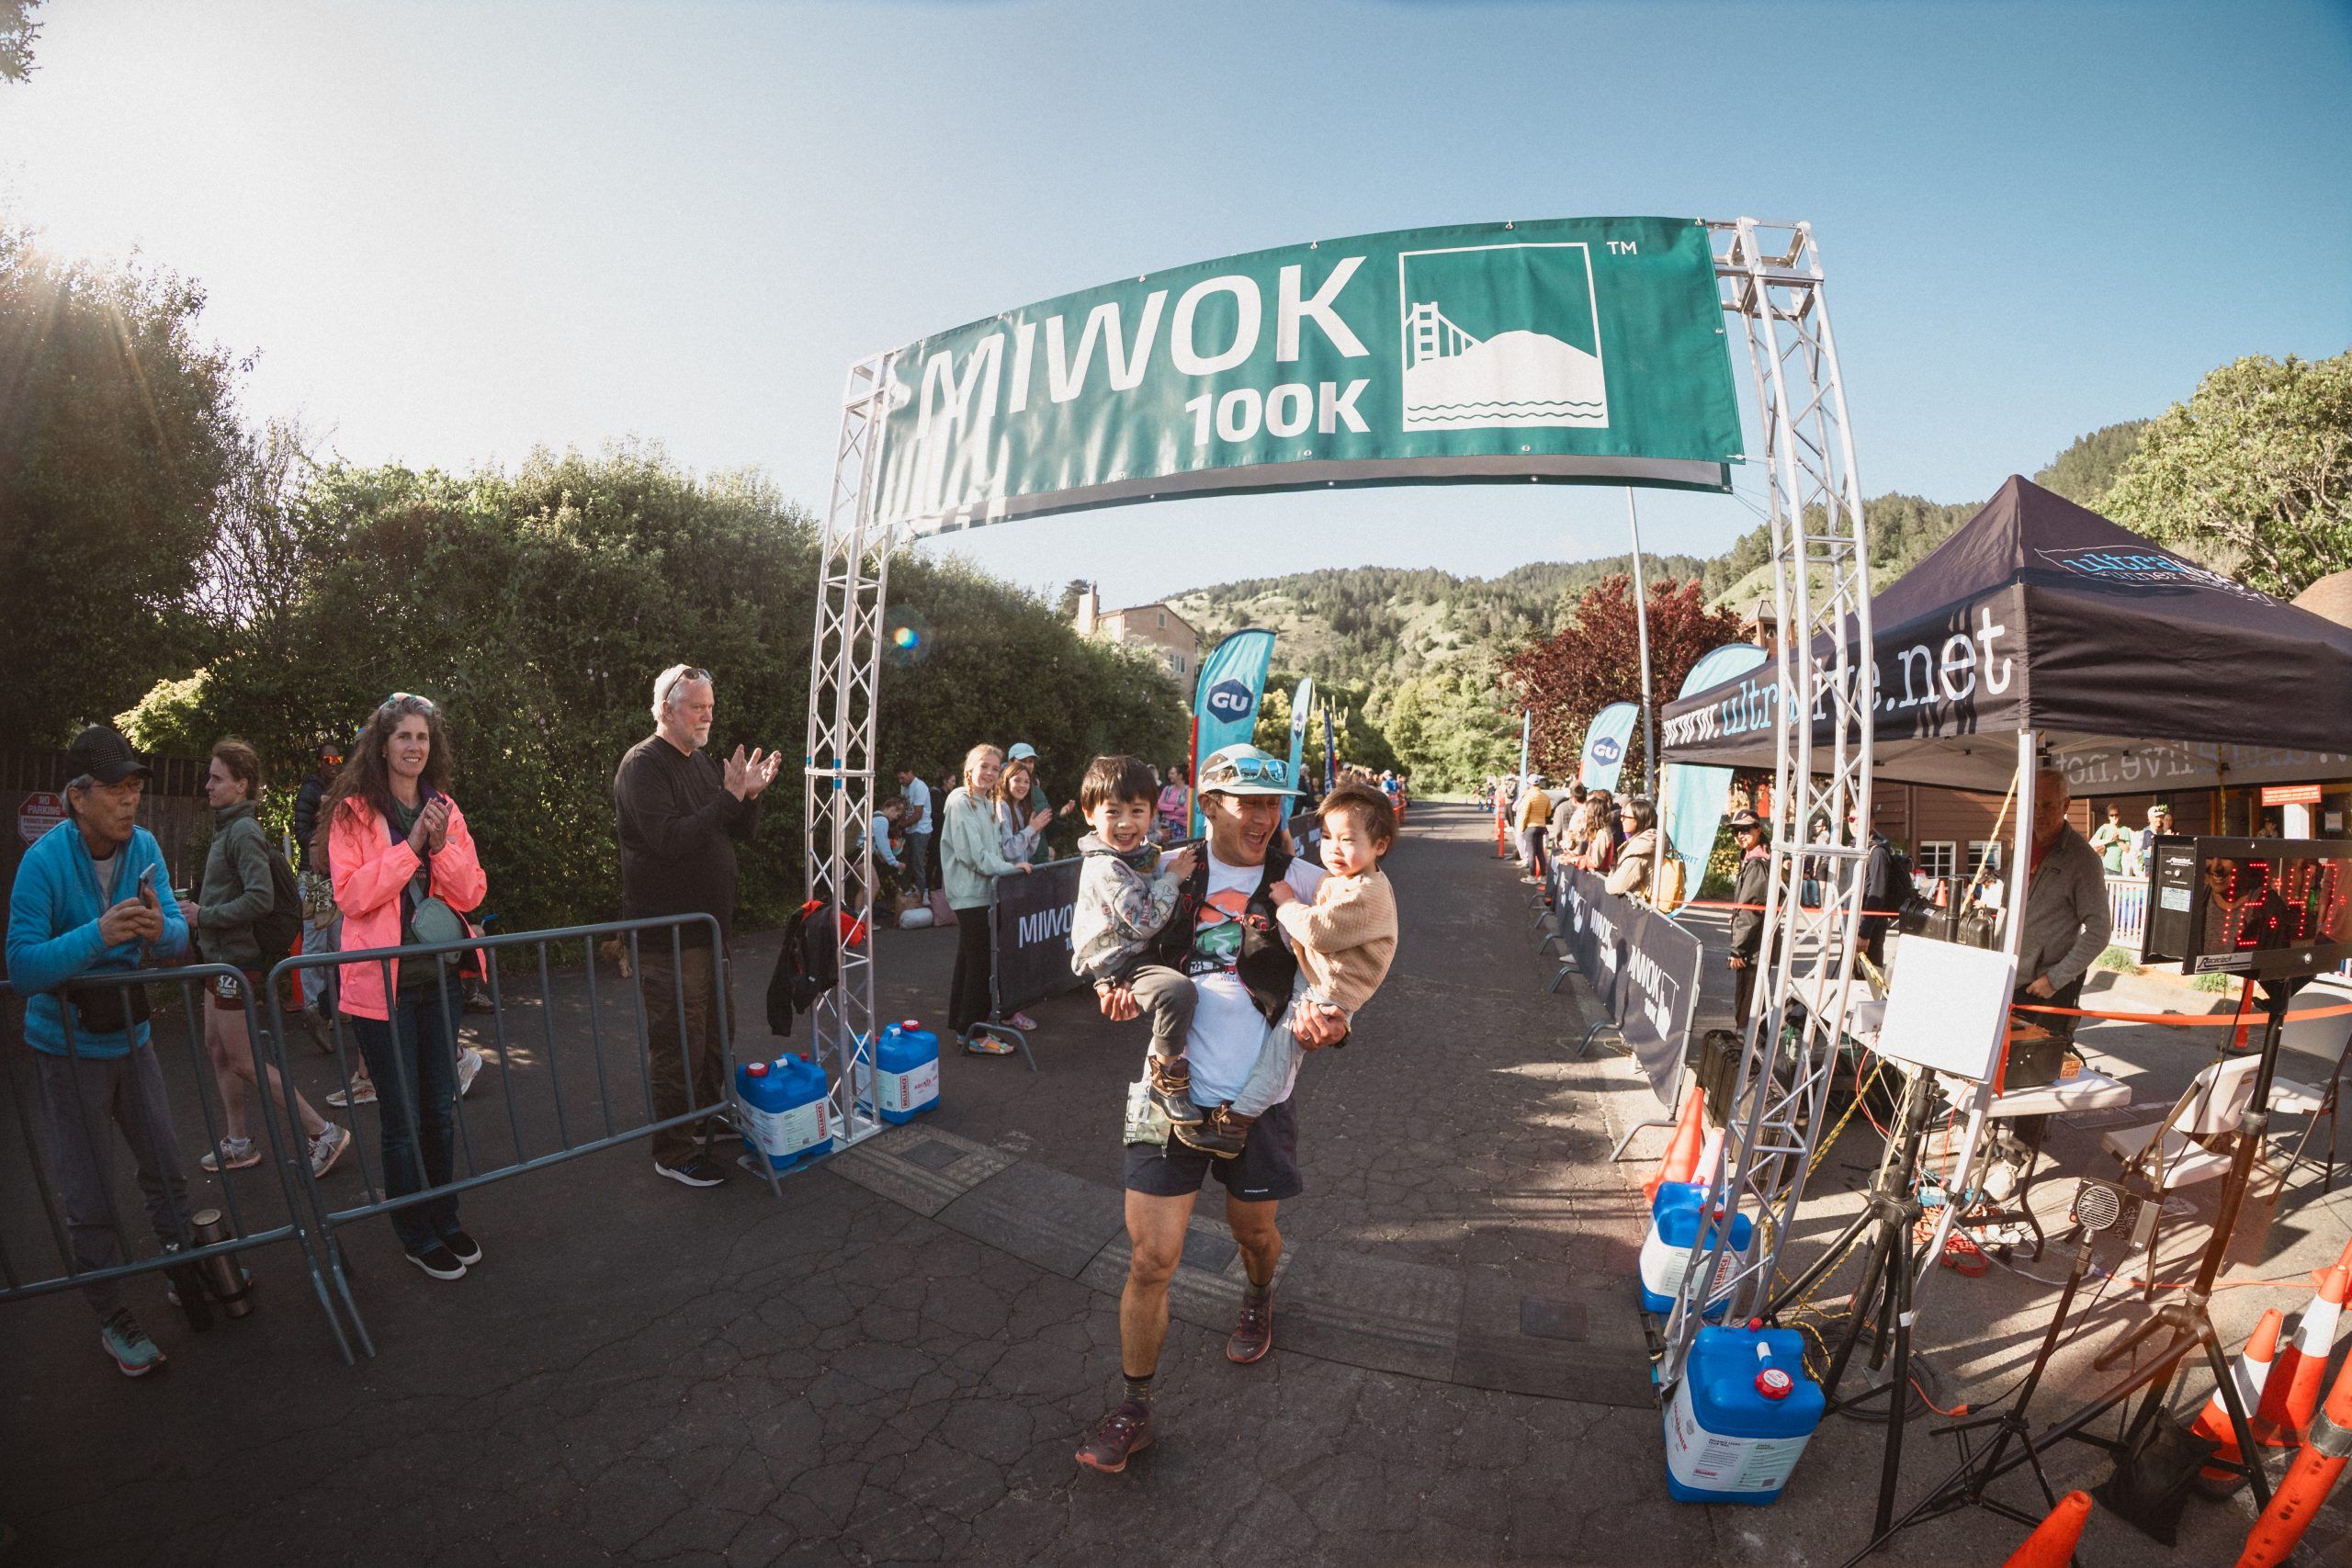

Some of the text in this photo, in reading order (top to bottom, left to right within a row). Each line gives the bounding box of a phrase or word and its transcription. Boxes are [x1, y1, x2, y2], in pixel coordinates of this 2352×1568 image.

[1606, 241, 1638, 256] TM
[916, 255, 1370, 439] MIWOK
[1185, 378, 1372, 446] 100K
[1211, 692, 1249, 712] GU
[1593, 743, 1620, 760] GU
[39, 795, 50, 805] NO
[28, 806, 61, 815] PARKING
[1019, 904, 1076, 949] MIWO
